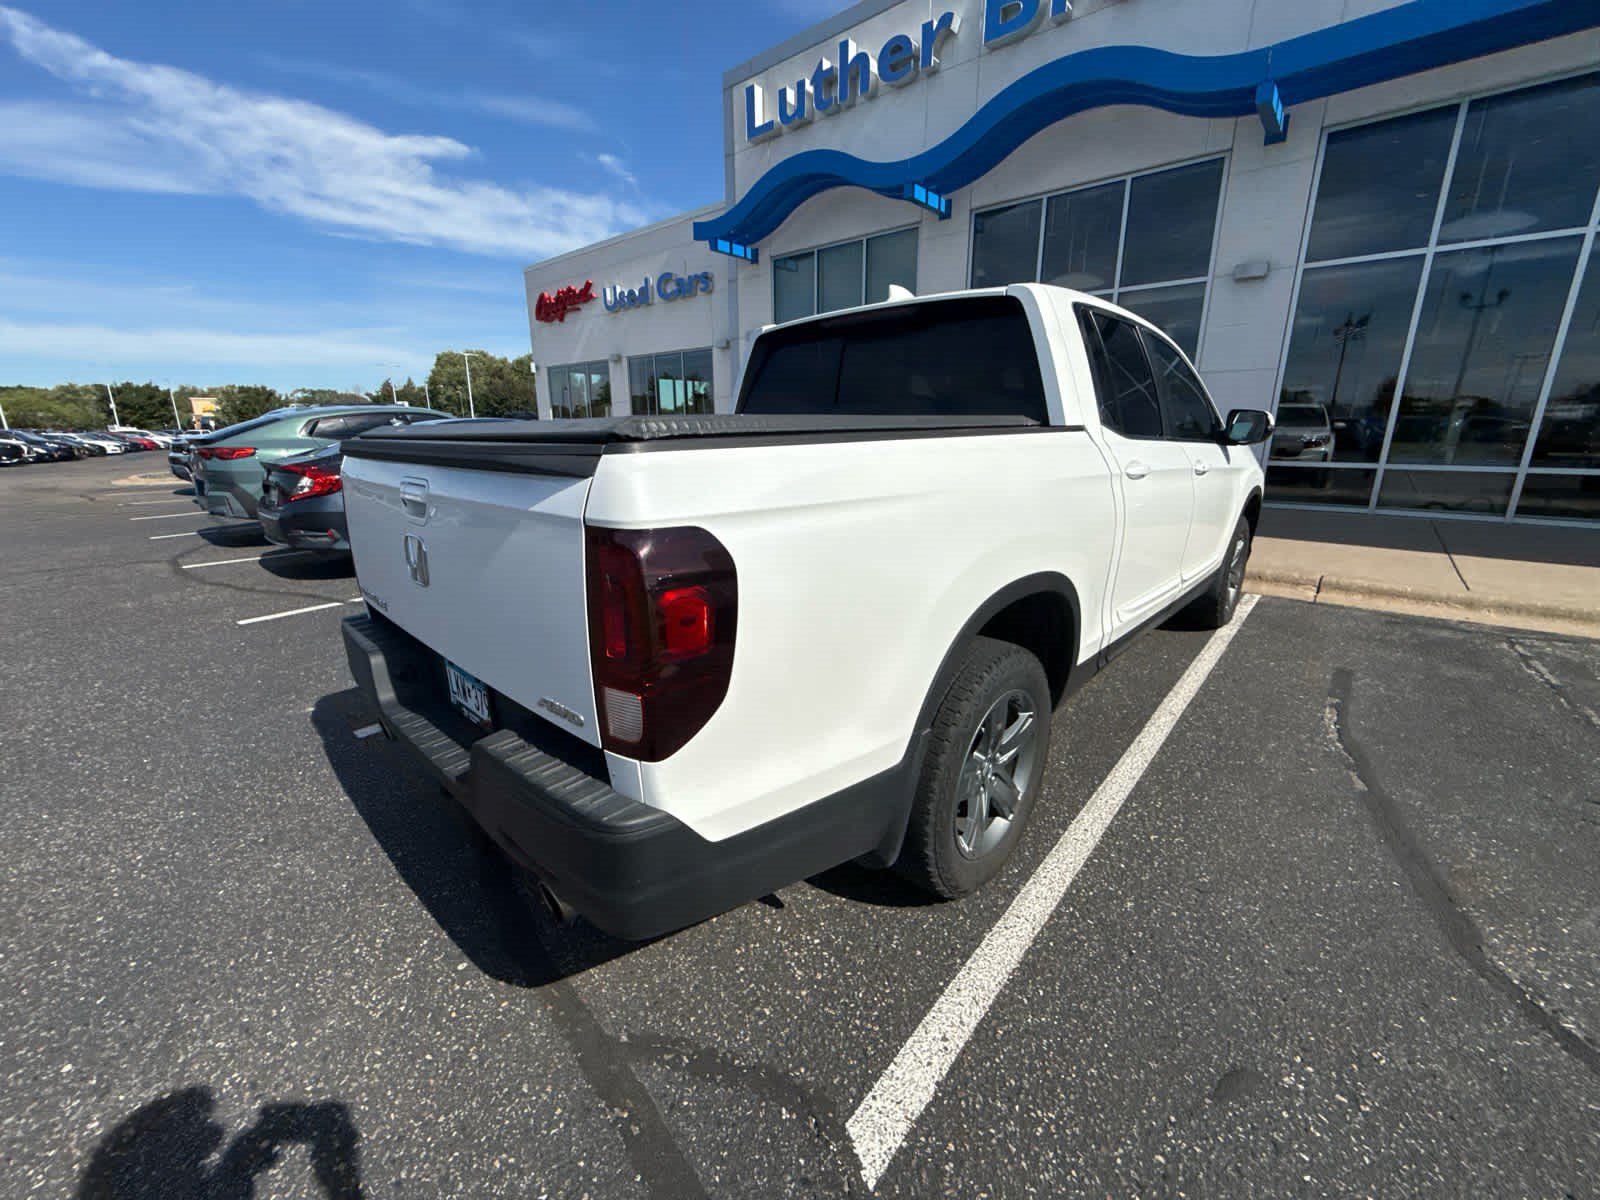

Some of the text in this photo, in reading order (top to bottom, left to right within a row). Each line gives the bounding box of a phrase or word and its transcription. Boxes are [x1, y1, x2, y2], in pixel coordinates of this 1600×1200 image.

[745, 11, 957, 143] Luther
[603, 276, 652, 312] Used
[656, 271, 713, 301] Cars
